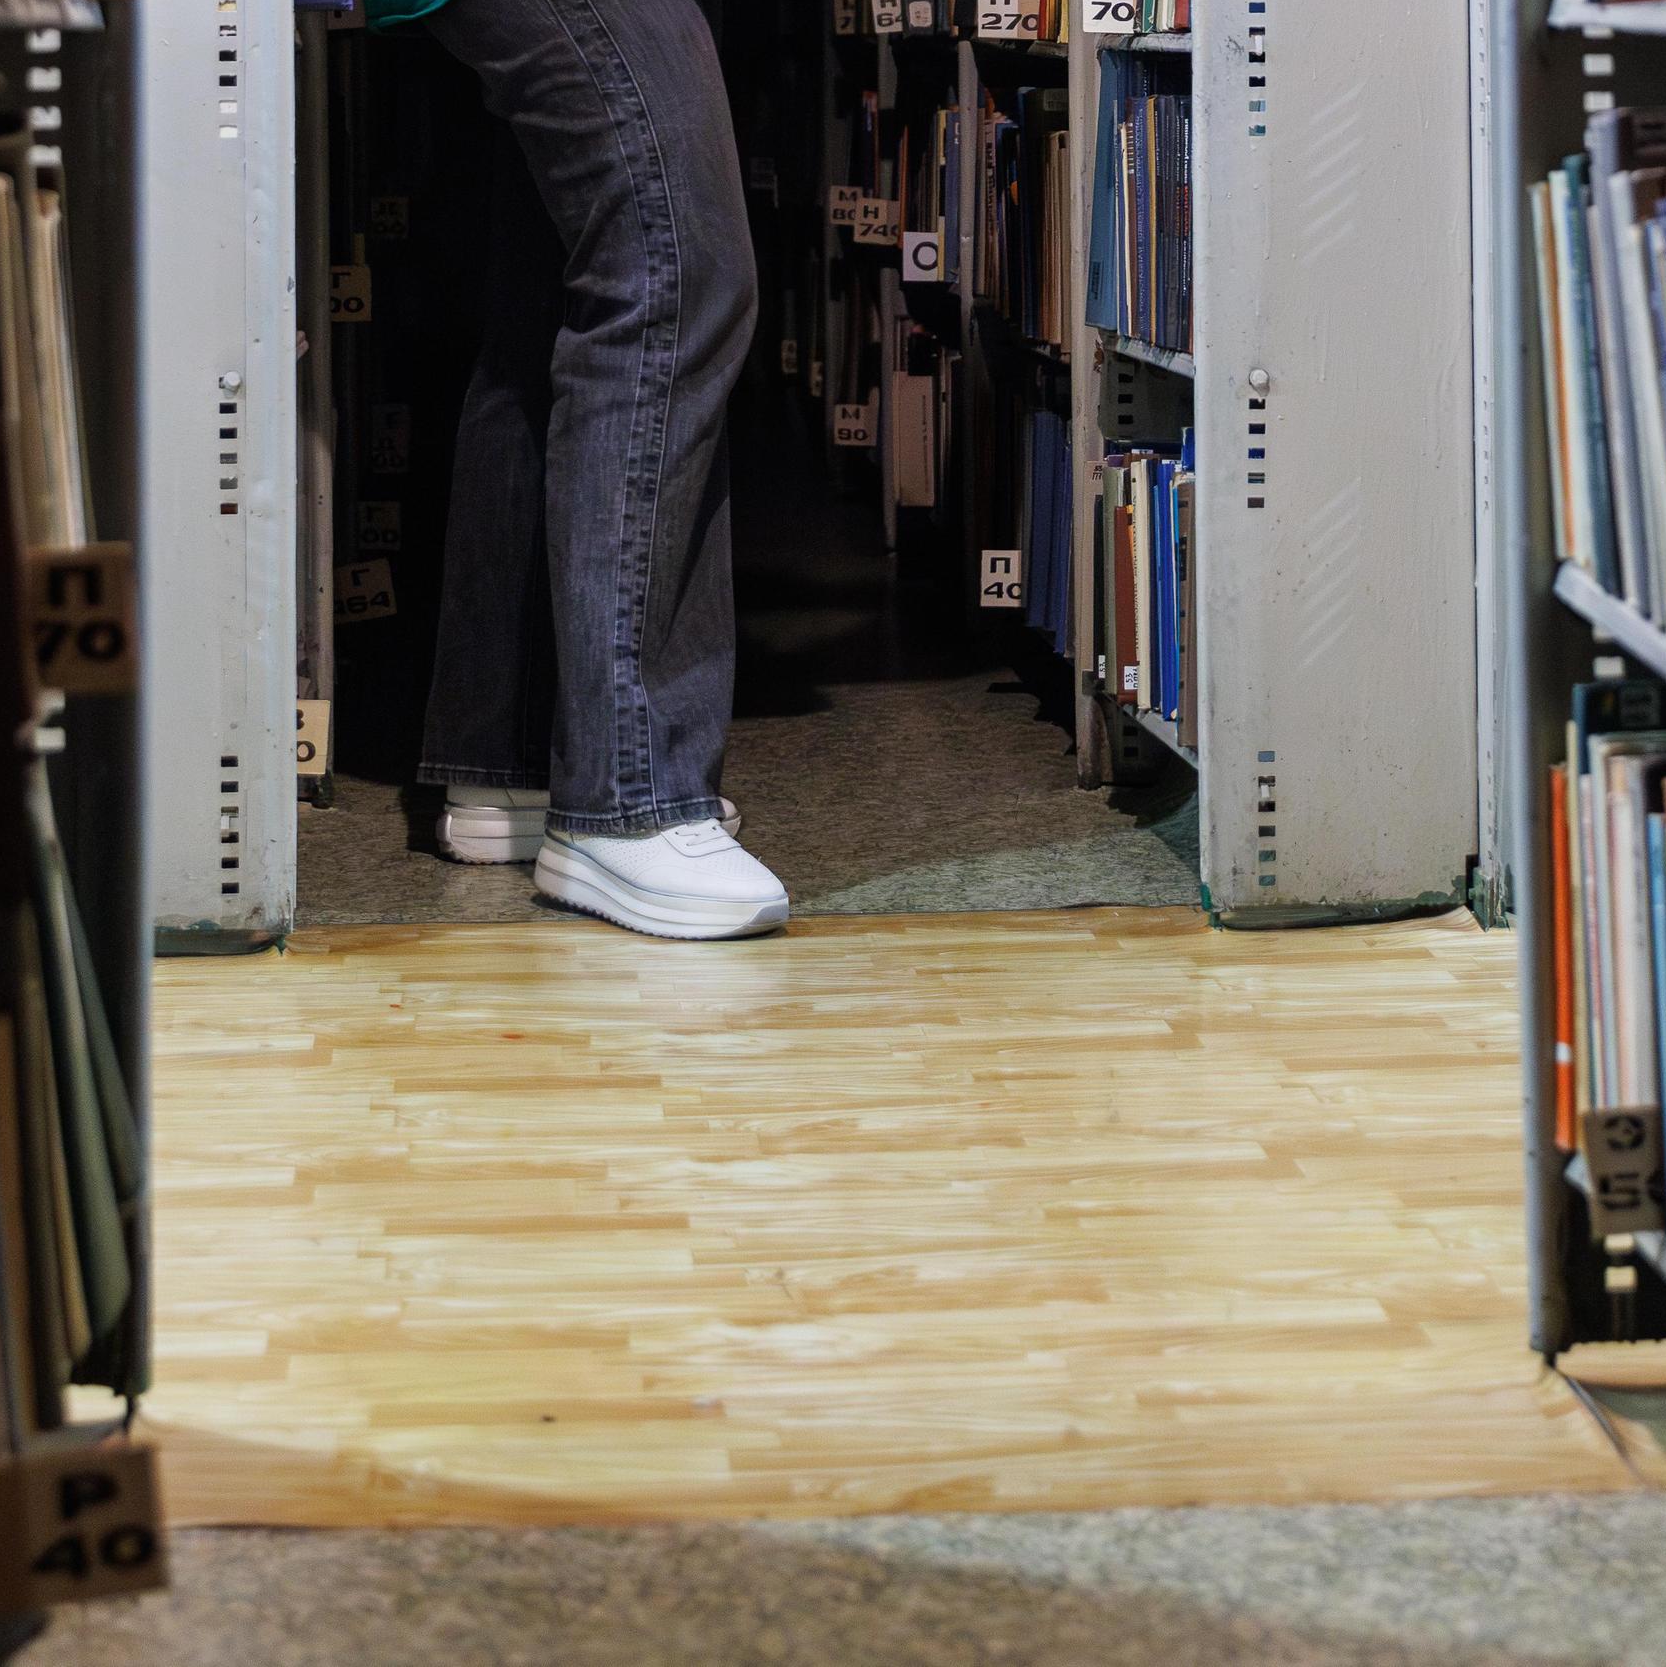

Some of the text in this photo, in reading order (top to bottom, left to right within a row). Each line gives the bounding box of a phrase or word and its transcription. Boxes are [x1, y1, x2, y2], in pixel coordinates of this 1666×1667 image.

[1091, 1, 1135, 22] 70
[981, 13, 1038, 31] 270
[863, 205, 879, 219] Н
[913, 241, 938, 270] О
[842, 407, 860, 420] М
[990, 557, 1011, 573] П
[48, 563, 102, 606] П
[984, 582, 1022, 599] 40
[35, 621, 124, 664] 70
[59, 1471, 117, 1519] Р
